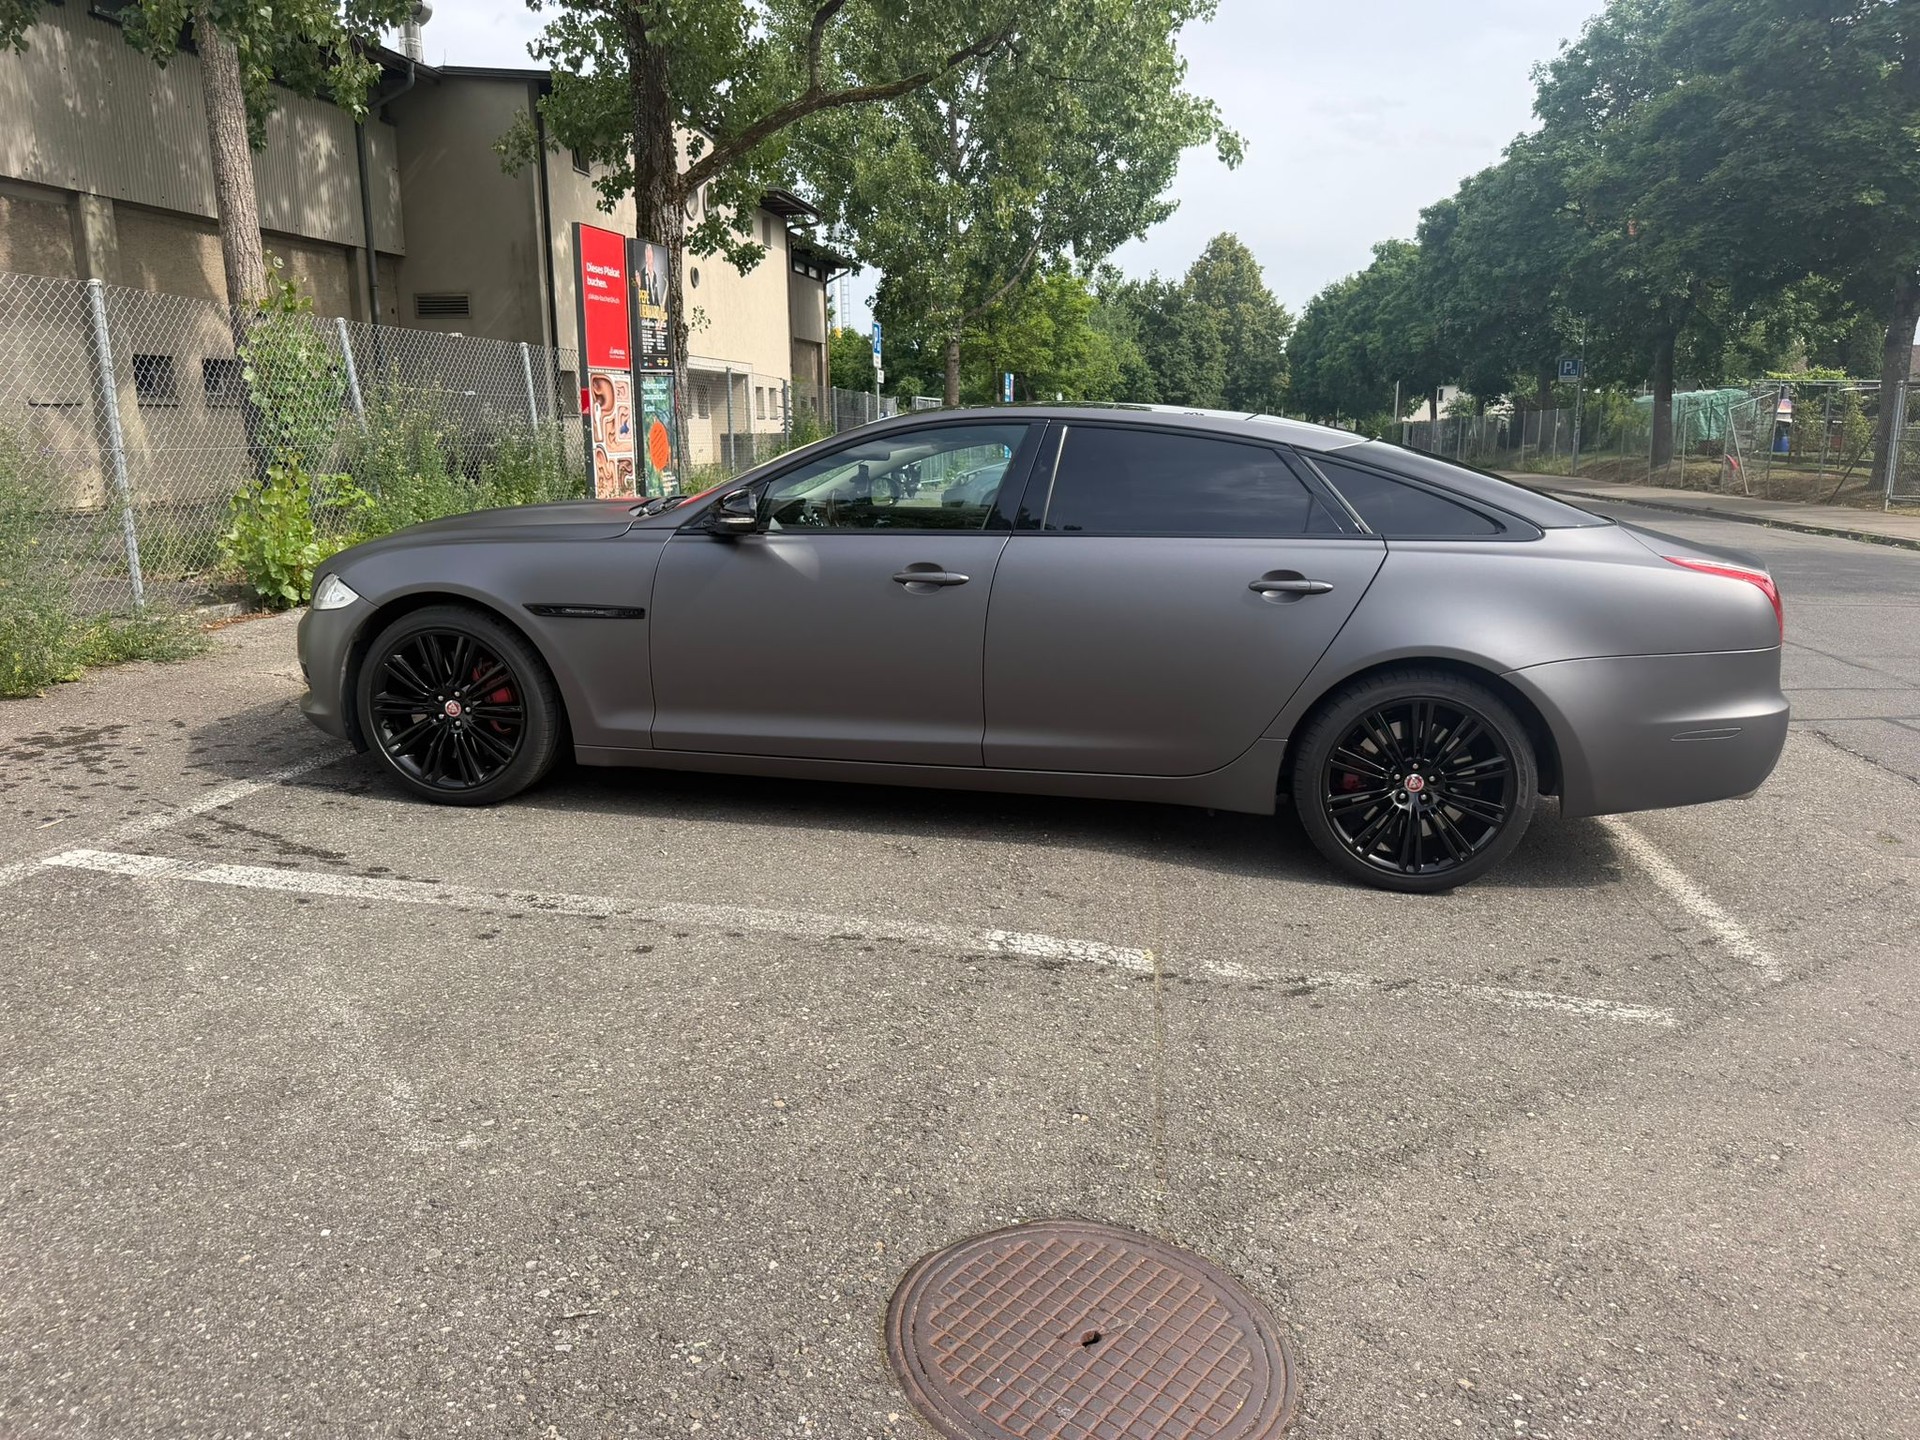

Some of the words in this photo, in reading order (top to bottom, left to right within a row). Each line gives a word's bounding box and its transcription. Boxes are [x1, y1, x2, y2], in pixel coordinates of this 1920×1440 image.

[586, 262, 603, 275] Dieses
[604, 266, 620, 278] Plakat
[587, 276, 607, 288] buchen.
[1564, 361, 1573, 374] P
